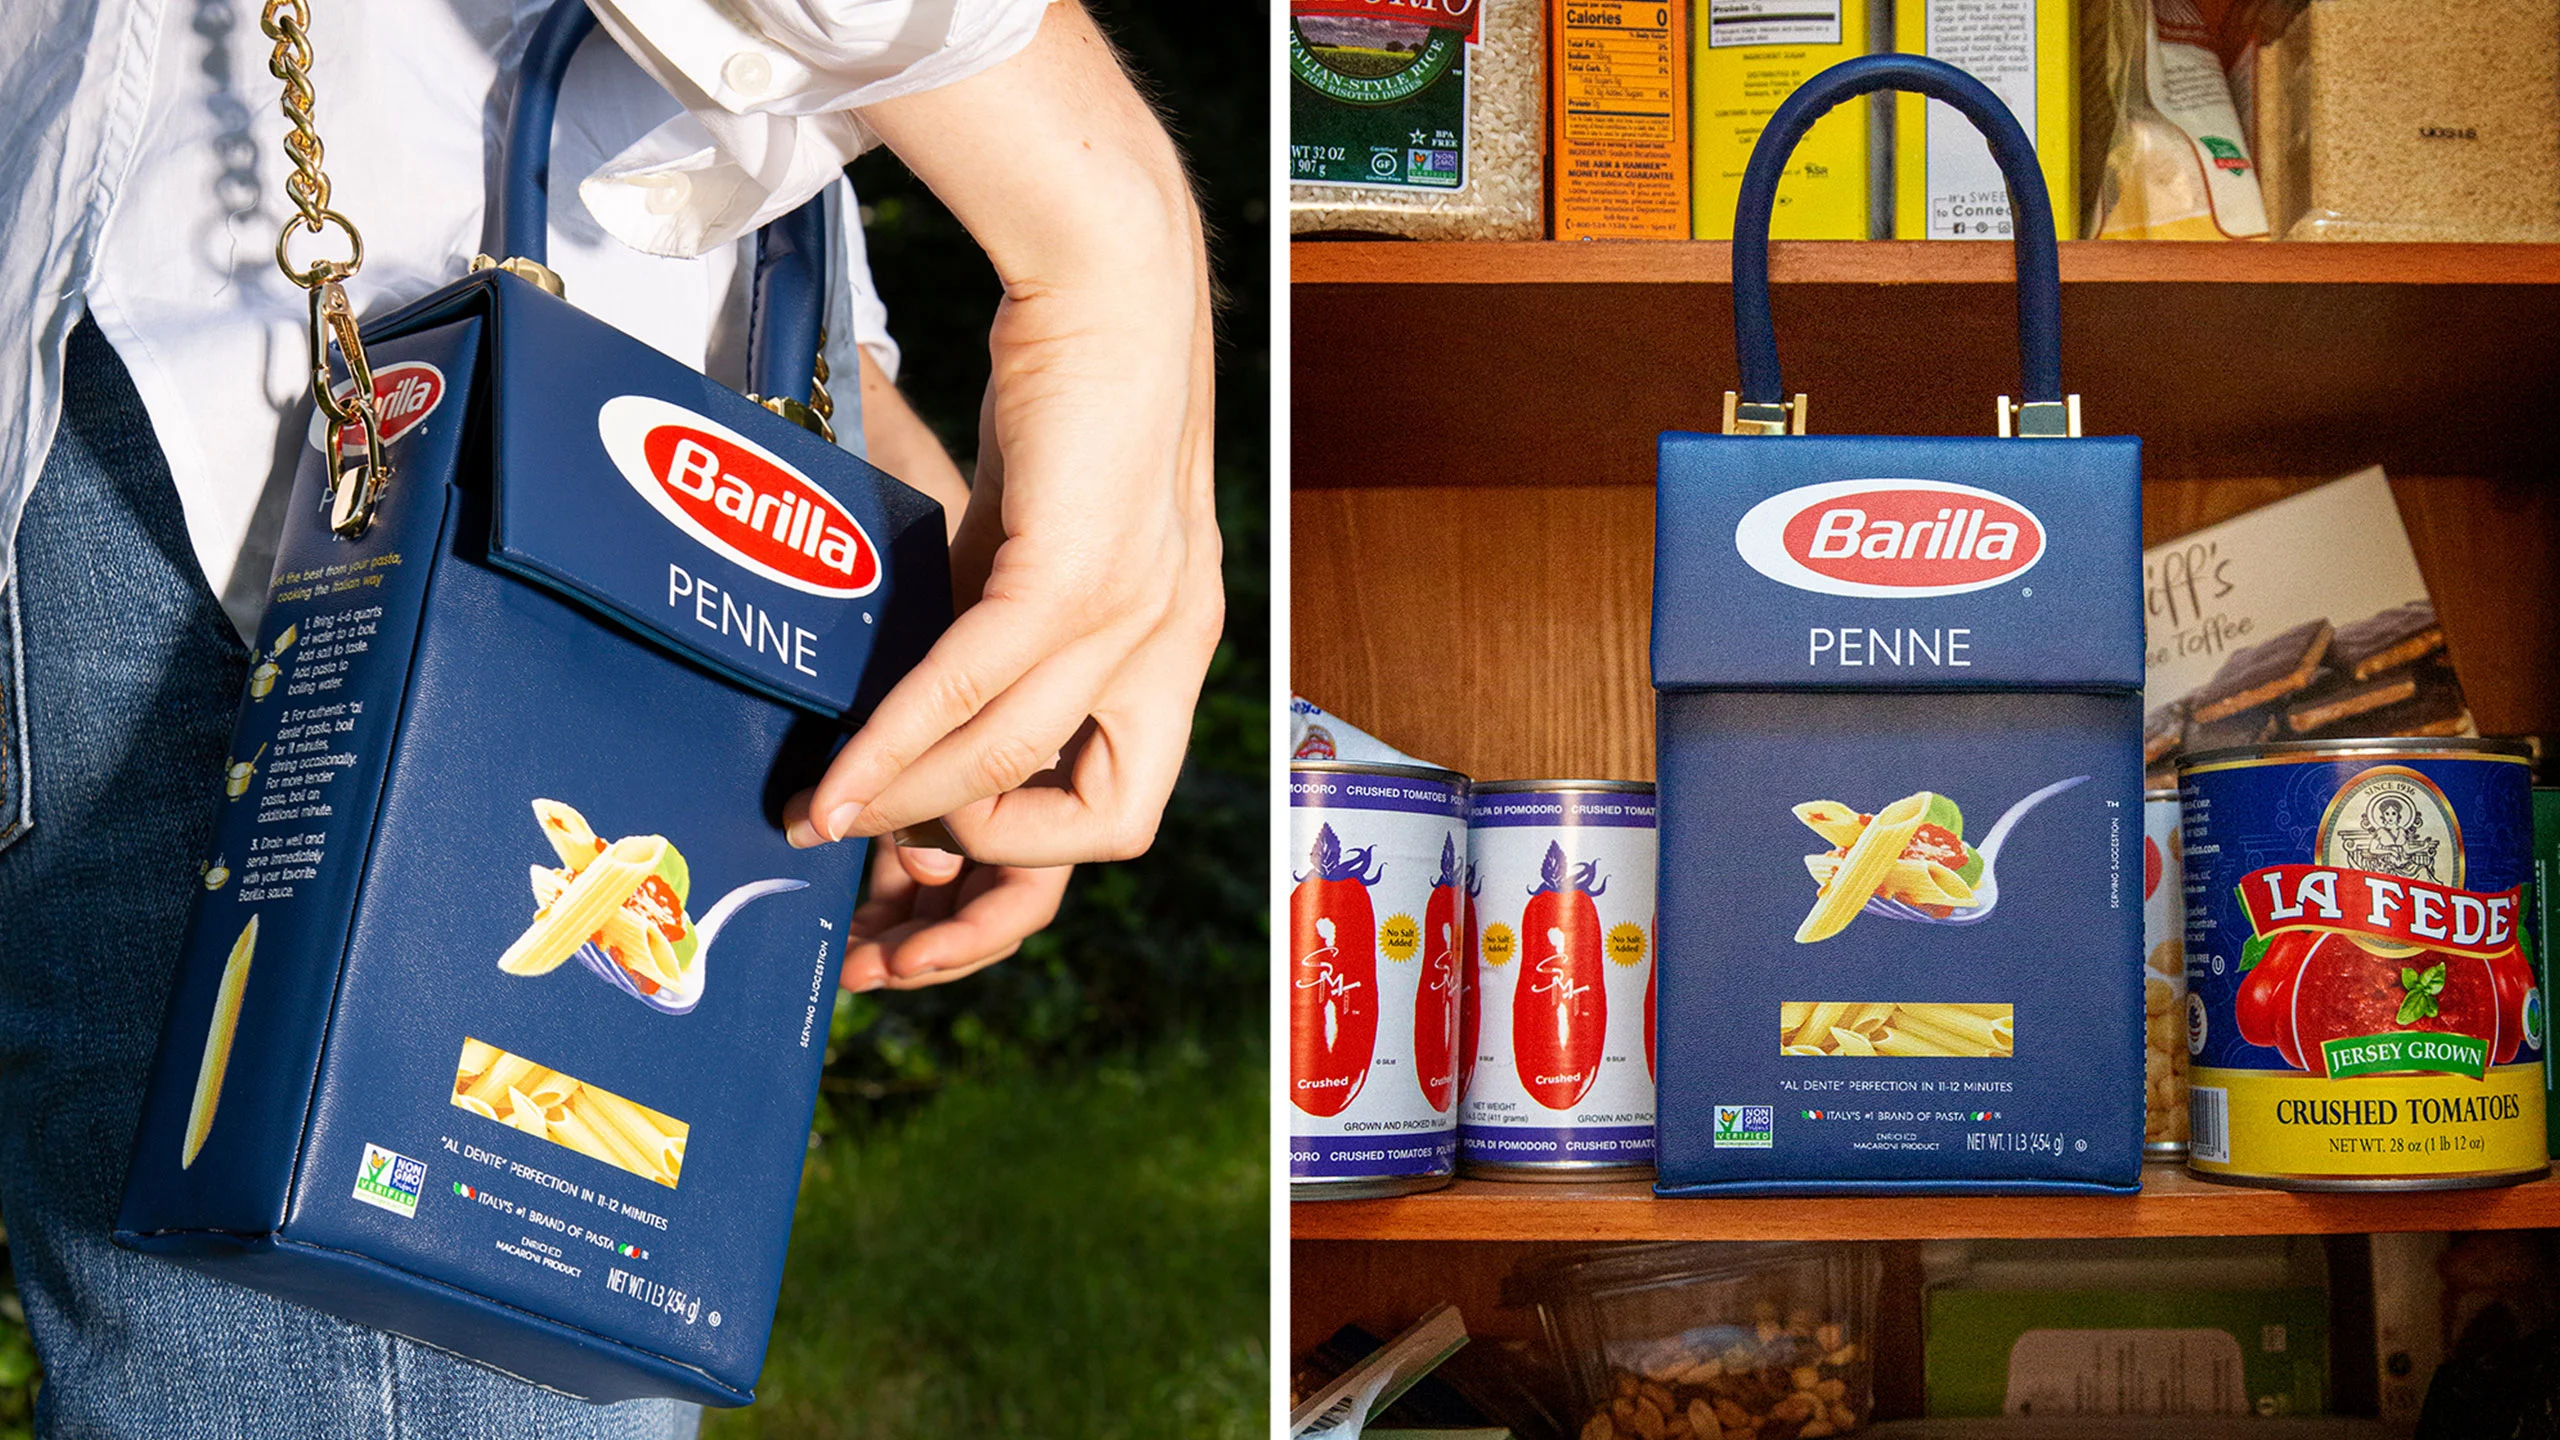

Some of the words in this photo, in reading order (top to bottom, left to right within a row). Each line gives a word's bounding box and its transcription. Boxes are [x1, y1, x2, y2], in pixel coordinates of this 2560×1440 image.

[1567, 9, 1621, 24] Calories
[1657, 9, 1667, 26] 0
[1410, 38, 1445, 77] RICE
[1303, 71, 1325, 89] FOR
[1327, 83, 1379, 100] RISOTTO
[1436, 130, 1454, 139] BPA
[1432, 139, 1458, 148] FREE
[1312, 146, 1325, 159] 32
[1328, 147, 1345, 160] OZ
[1435, 152, 1454, 160] NON
[1298, 160, 1317, 173] 907
[1319, 164, 1326, 177] g
[1376, 160, 1391, 169] GF
[1948, 194, 1965, 203] It's
[1937, 209, 1948, 217] to
[666, 438, 858, 576] Barilla
[1807, 507, 2020, 562] Barilla
[303, 567, 323, 581] best
[325, 565, 346, 577] from
[277, 587, 312, 602] cooking
[314, 584, 329, 596] the
[312, 615, 334, 628] Bring
[353, 606, 383, 623] quarts
[669, 563, 818, 678] PENNE
[312, 630, 336, 644] water
[348, 627, 355, 638] a
[2171, 614, 2254, 658] Toffee
[1809, 627, 1972, 667] PENNE
[296, 650, 315, 662] Add
[291, 709, 306, 722] For
[335, 718, 355, 732] boil
[281, 776, 303, 787] more
[307, 790, 320, 800] an
[1346, 785, 1400, 798] CRUSHED
[1403, 789, 1447, 804] TOMATOES
[2364, 782, 2394, 797] SINCE
[2396, 782, 2416, 796] 1936
[1494, 806, 1502, 815] DI
[1504, 805, 1563, 815] POMODORO
[1571, 805, 1622, 815] CRUSHED
[305, 832, 326, 845] and
[2261, 870, 2343, 921] LA
[2364, 876, 2511, 947] FEDE
[1387, 927, 1401, 938] No
[1402, 928, 1415, 938] Salt
[1613, 935, 1625, 944] No
[1627, 935, 1640, 944] Salt
[1387, 938, 1413, 948] Added
[1614, 944, 1639, 953] Added
[2330, 1042, 2404, 1072] JERSEY
[2407, 1040, 2482, 1067] GROWN
[1297, 1076, 1349, 1090] Crushed
[1535, 1072, 1581, 1085] Crushed
[1849, 1080, 1918, 1092] PERFECTION
[1922, 1081, 1933, 1092] IN
[1938, 1081, 1961, 1093] 11-12
[1964, 1082, 2013, 1093] MINUTES
[1487, 1102, 1516, 1111] WEIGHT
[1745, 1108, 1770, 1118] NON
[2276, 1097, 2398, 1126] CRUSHED
[2406, 1094, 2519, 1124] TOMATOES
[1503, 1114, 1529, 1123] grams)
[1577, 1114, 1613, 1123] GROWN
[1615, 1113, 1633, 1122] AND
[1745, 1116, 1770, 1125] GMO
[1826, 1110, 1861, 1121] ITALY'S
[1877, 1111, 1914, 1122] BRAND
[1917, 1111, 1933, 1122] OF
[1935, 1112, 1966, 1122] PASTA
[1343, 1122, 1382, 1132] GROWN
[1383, 1121, 1401, 1131] AND
[1402, 1119, 1431, 1130] PACKED
[1715, 1132, 1772, 1140] VERIFIED
[1966, 1133, 1987, 1151] NET
[1487, 1140, 1496, 1149] DI
[1498, 1141, 1557, 1151] POMODORO
[1566, 1141, 1617, 1151] CRUSHED
[1901, 1141, 1940, 1152] PRODUCT
[2329, 1138, 2357, 1153] NET
[2357, 1138, 2386, 1153] WT.
[2390, 1137, 2405, 1153] 28
[2407, 1139, 2423, 1153] oz
[2425, 1137, 2436, 1156] (1
[2439, 1136, 2451, 1152] lb
[2454, 1135, 2466, 1151] 12
[2469, 1135, 2485, 1153] oz)
[1330, 1150, 1385, 1162] CRUSHED
[1388, 1147, 1433, 1160] TOMATOES
[396, 1158, 421, 1177] NON
[393, 1168, 420, 1187] GMO
[358, 1178, 415, 1207] VERIFIED
[510, 1162, 579, 1197] PERFECTION
[581, 1188, 594, 1202] IN
[597, 1193, 619, 1212] 11-12
[621, 1203, 668, 1232] MINUTES
[477, 1191, 513, 1213] ITALY'S
[529, 1210, 566, 1233] BRAND
[567, 1224, 583, 1238] OF
[585, 1229, 615, 1251] PASTA
[606, 1267, 629, 1293] NET
